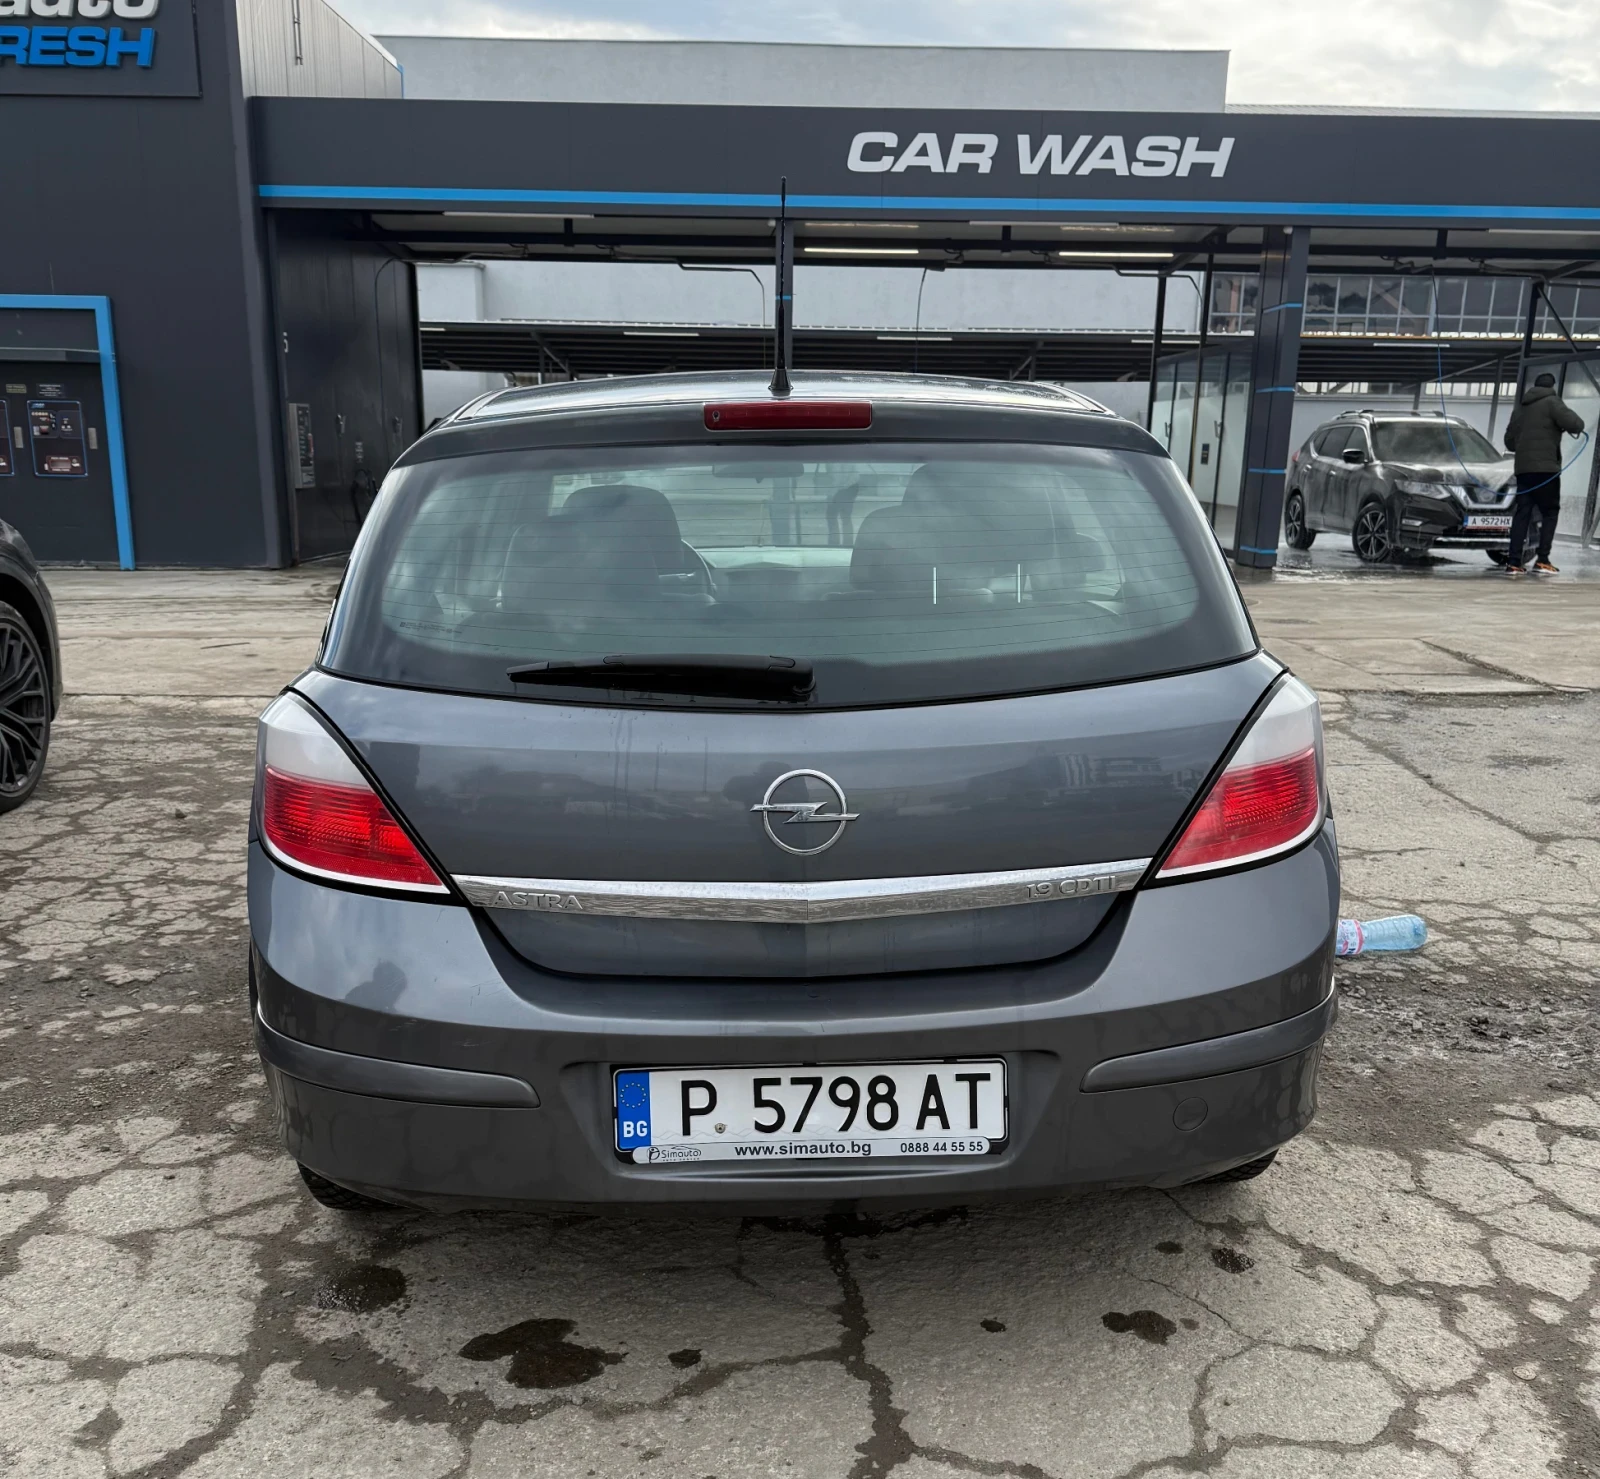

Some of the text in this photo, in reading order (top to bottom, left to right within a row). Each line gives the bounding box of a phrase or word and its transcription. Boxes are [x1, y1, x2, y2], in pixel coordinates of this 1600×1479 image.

[847, 132, 1235, 177] CAR WASH
[1481, 517, 1500, 525] 9572
[1060, 876, 1115, 894] CDTI
[491, 890, 584, 910] ASTRA
[681, 1072, 991, 1136] P 5798 AT
[623, 1120, 648, 1138] BG
[661, 1149, 699, 1159] Simauto
[734, 1141, 872, 1156] www.simauto.bg
[900, 1140, 984, 1153] 0888 44 55 55
